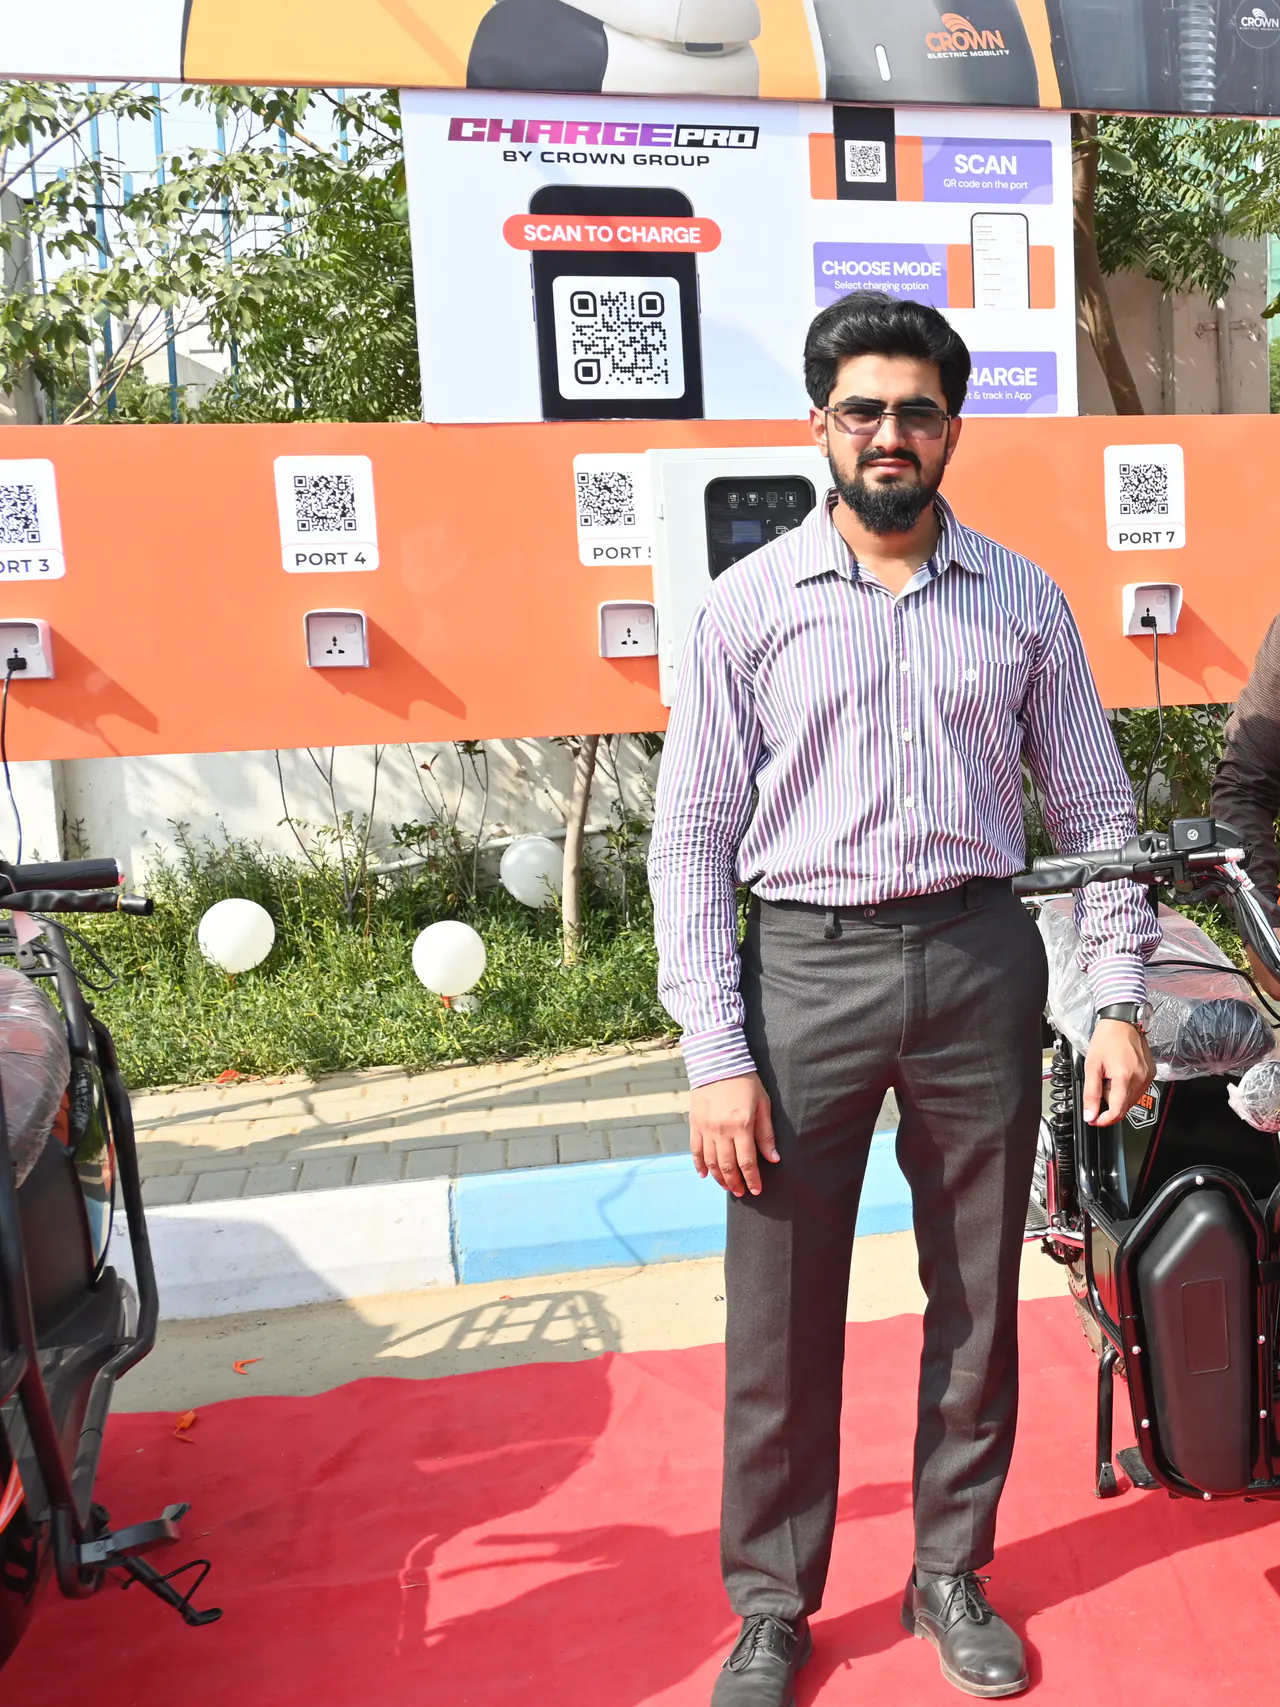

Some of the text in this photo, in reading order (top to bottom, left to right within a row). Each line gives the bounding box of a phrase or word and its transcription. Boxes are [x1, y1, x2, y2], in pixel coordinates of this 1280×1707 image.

[1240, 16, 1279, 28] CROWN
[925, 28, 1005, 52] CROWN
[926, 49, 1010, 59] ELECTRIC MOBILITY
[502, 150, 711, 167] BY CROWN GROUP
[954, 153, 1018, 176] SCAN
[943, 178, 1029, 191] QR code on the port
[523, 224, 702, 244] SCAN TO CHARGE
[821, 260, 942, 277] CHOOSE MODE
[834, 280, 929, 292] Select charging option
[968, 366, 1038, 387] HARGE
[973, 391, 981, 400] &
[982, 391, 1004, 400] track
[1004, 391, 1013, 400] in
[1014, 391, 1032, 402] App
[1118, 531, 1176, 545] PORT 7
[295, 551, 367, 567] PORT 4
[592, 546, 643, 560] PORT
[38, 558, 50, 572] 3
